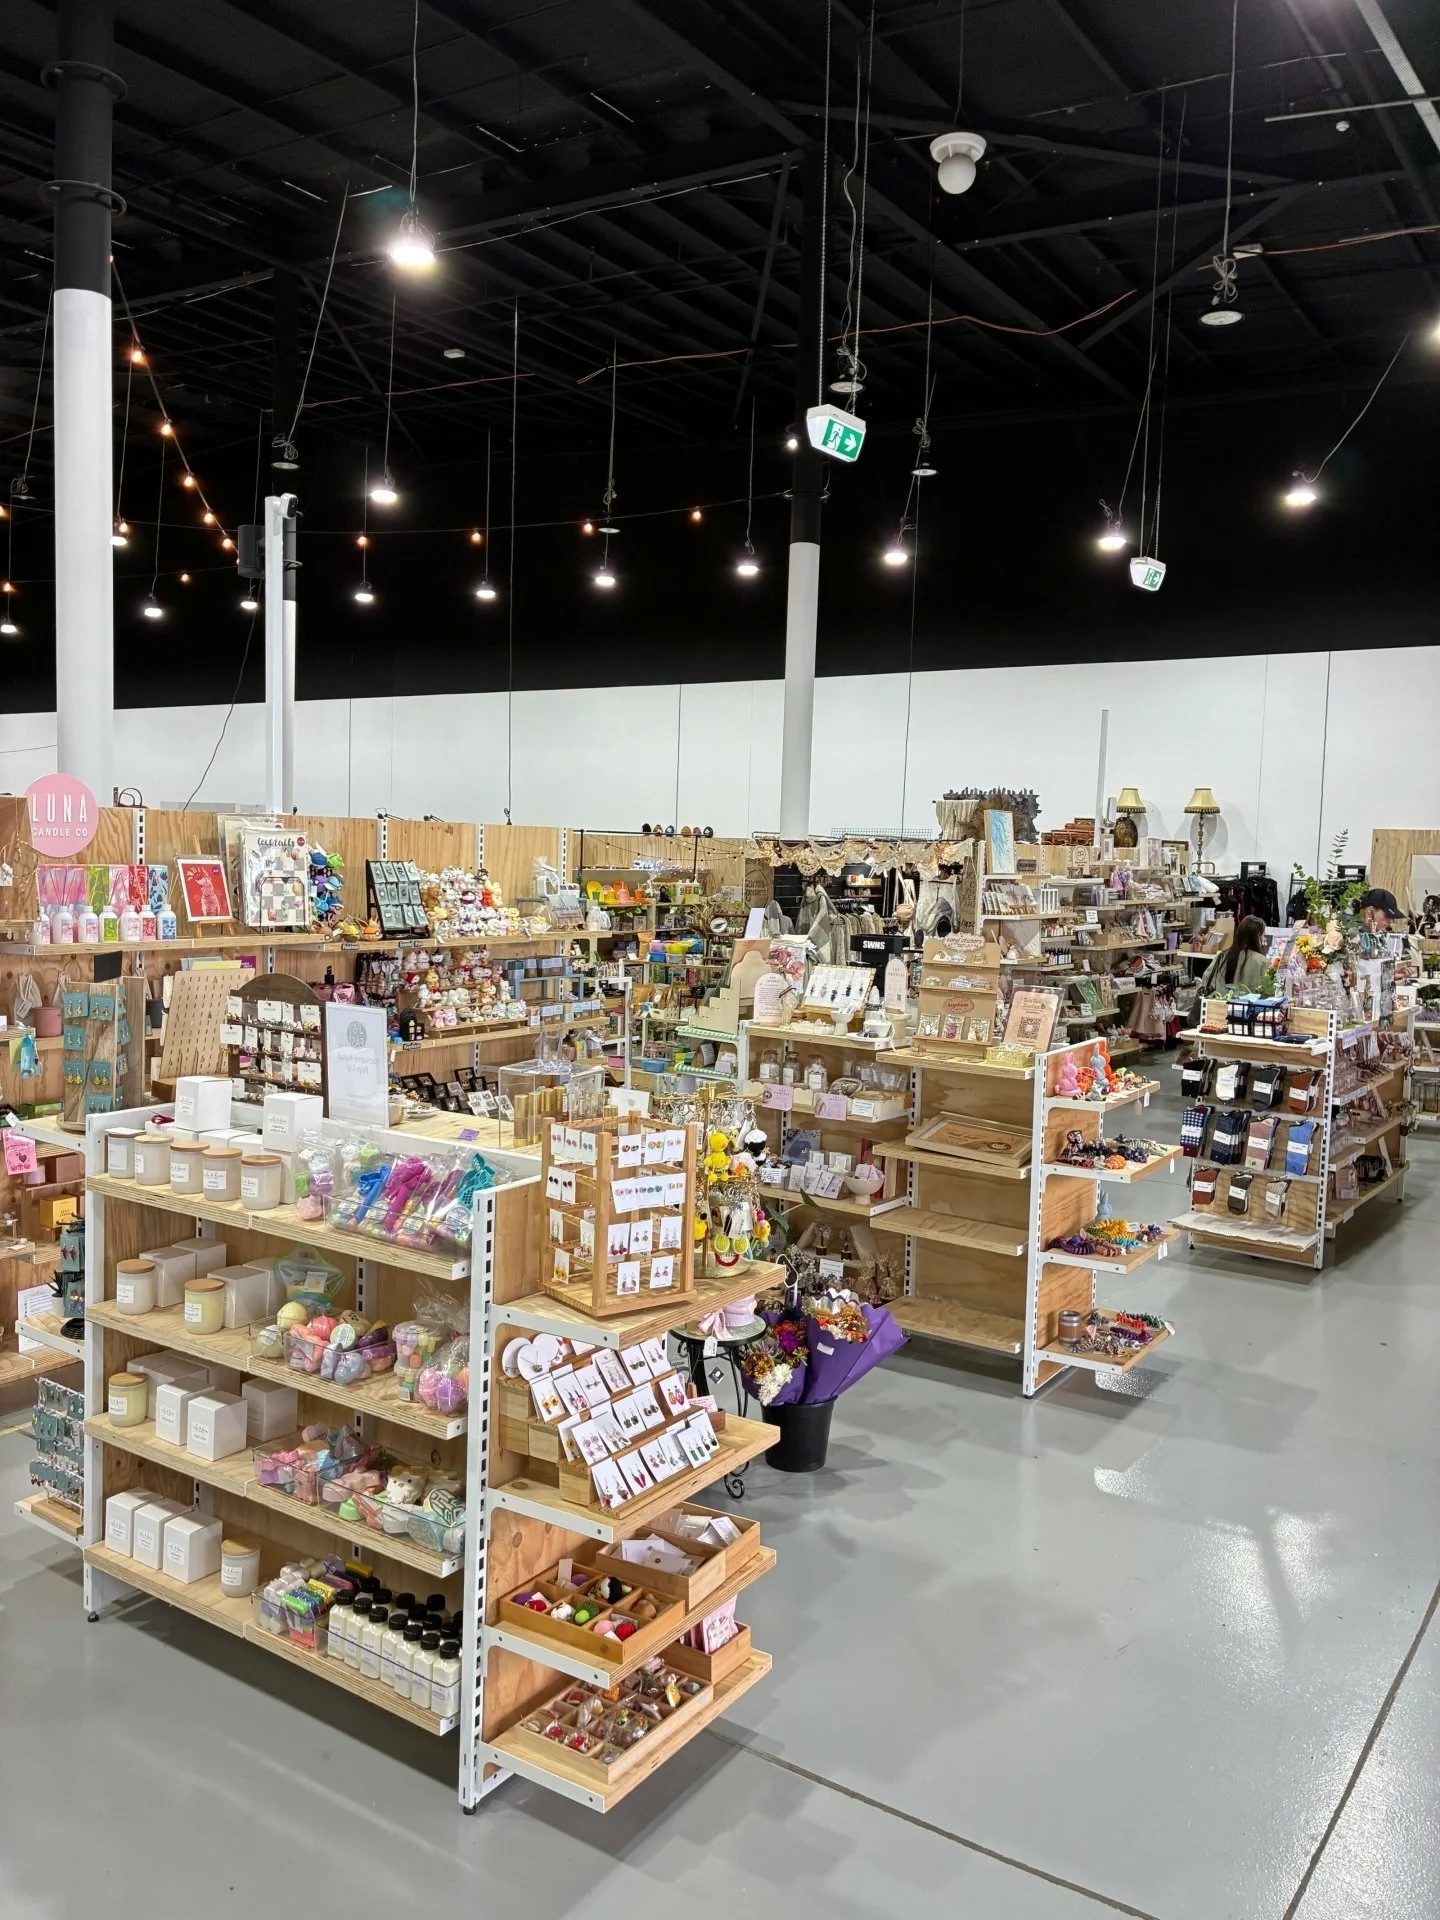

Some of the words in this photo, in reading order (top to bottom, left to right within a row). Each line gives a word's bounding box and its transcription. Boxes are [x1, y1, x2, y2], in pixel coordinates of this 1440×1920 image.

[32, 793, 88, 823] LUNA
[32, 826, 71, 837] CANDLE
[75, 828, 88, 837] CO
